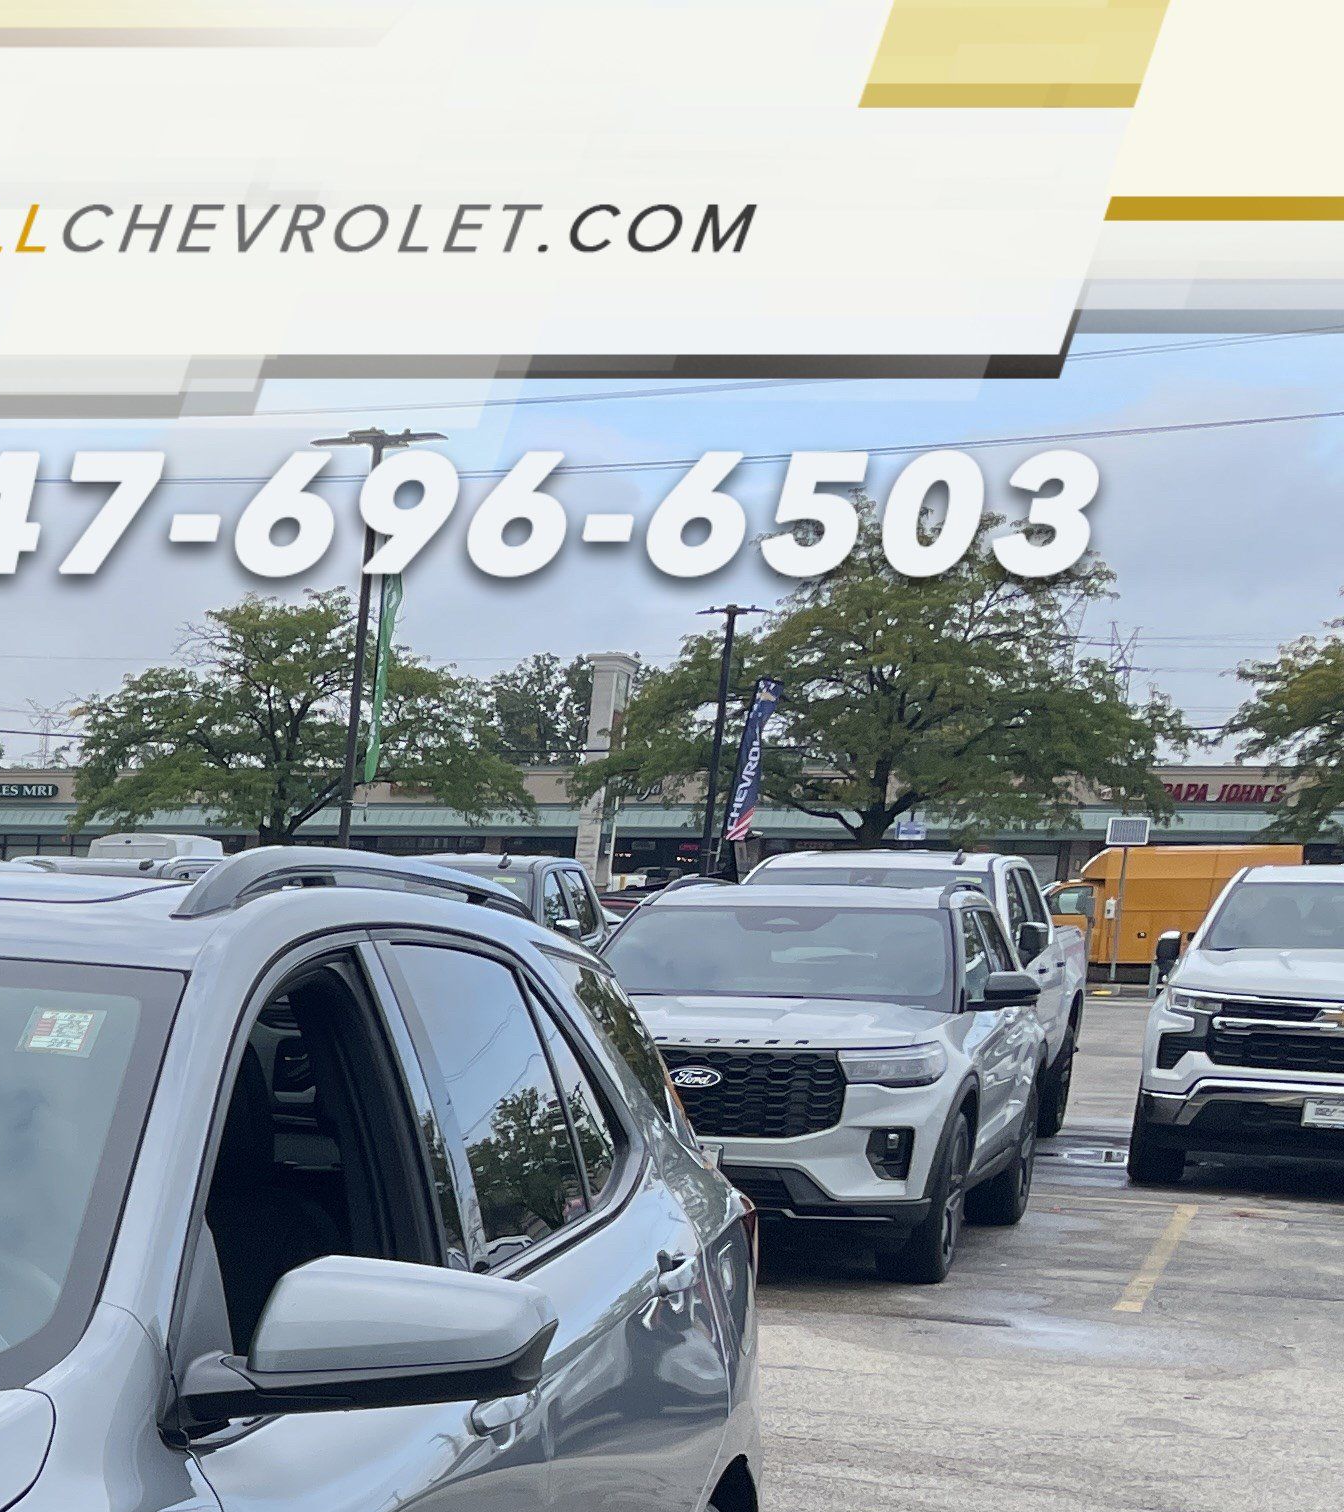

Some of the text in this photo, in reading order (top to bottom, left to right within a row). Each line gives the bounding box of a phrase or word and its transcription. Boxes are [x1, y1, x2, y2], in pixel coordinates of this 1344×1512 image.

[726, 722, 762, 832] CHEVROL
[22, 784, 53, 796] MRI
[1163, 783, 1209, 802] PAPA
[674, 1070, 712, 1085] Ford
